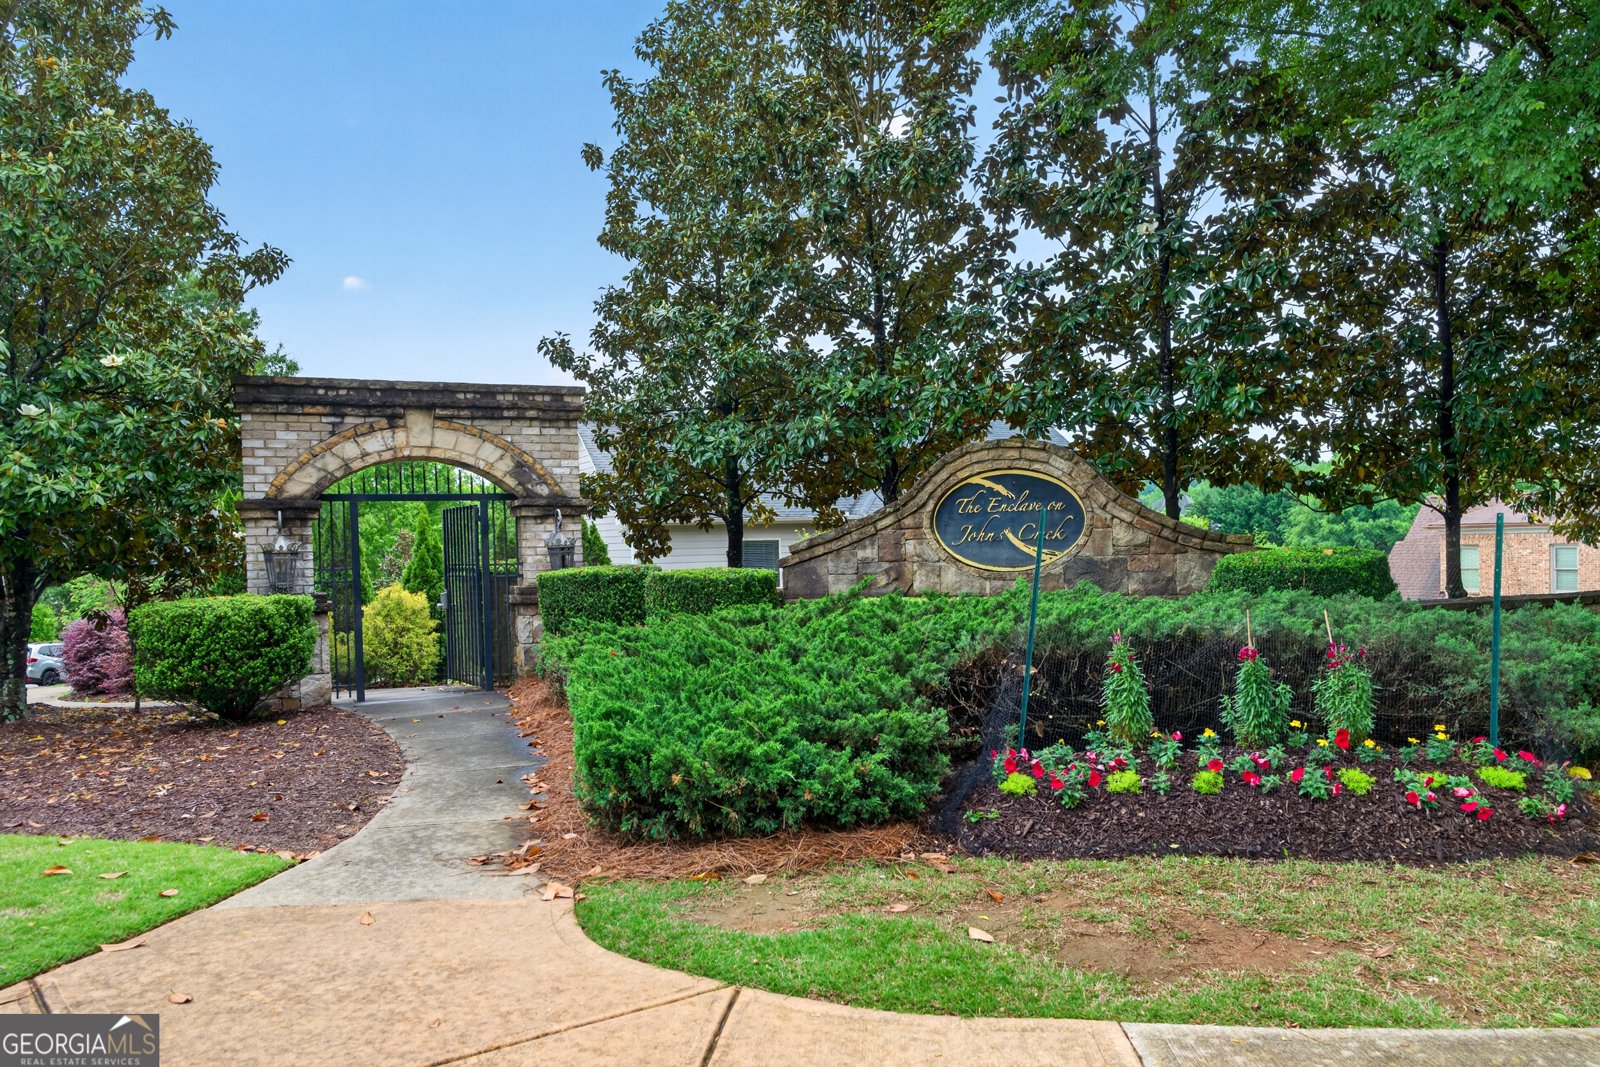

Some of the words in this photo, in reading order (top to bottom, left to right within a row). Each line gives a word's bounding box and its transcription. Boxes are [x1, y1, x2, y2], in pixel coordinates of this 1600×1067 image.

[956, 489, 987, 514] The
[987, 489, 1043, 513] Enclave
[1047, 500, 1066, 512] on
[951, 515, 1005, 546] Johns
[1018, 515, 1074, 541] Crek
